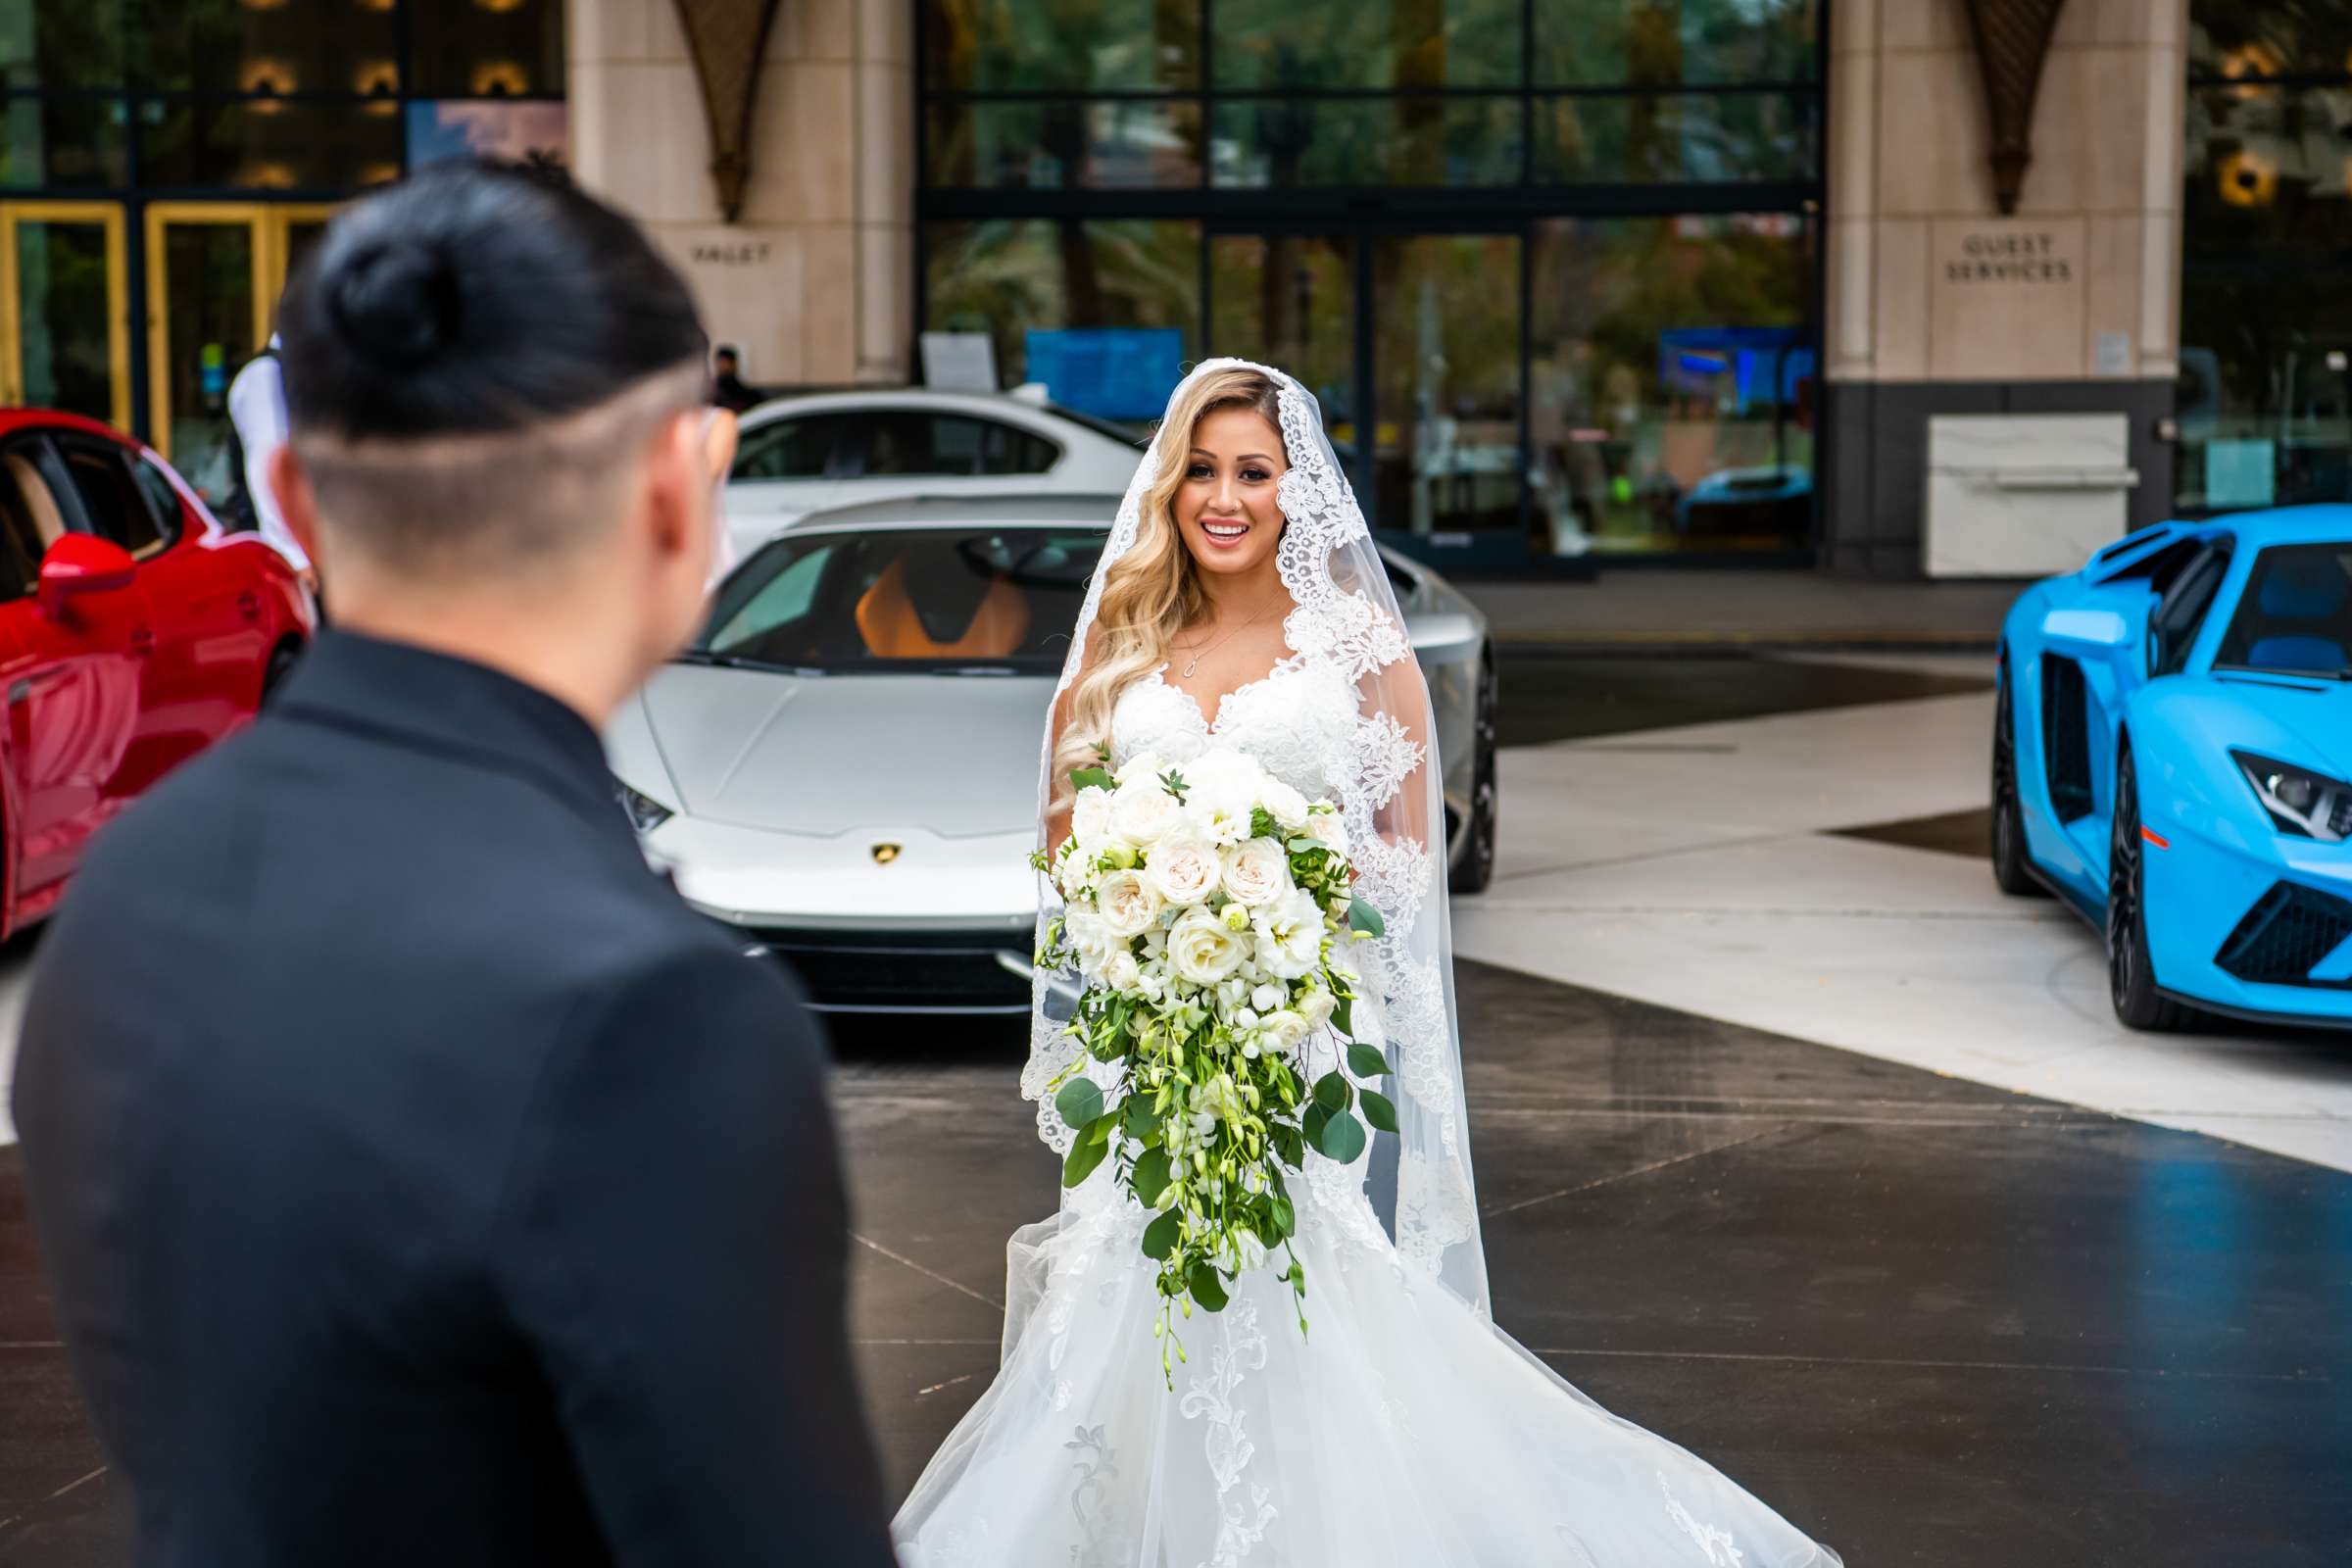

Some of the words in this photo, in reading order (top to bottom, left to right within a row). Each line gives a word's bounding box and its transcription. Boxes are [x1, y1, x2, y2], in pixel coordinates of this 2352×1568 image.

[691, 243, 770, 266] VALET
[1964, 233, 2053, 258] GUEST
[1945, 260, 2071, 282] SERVICES
